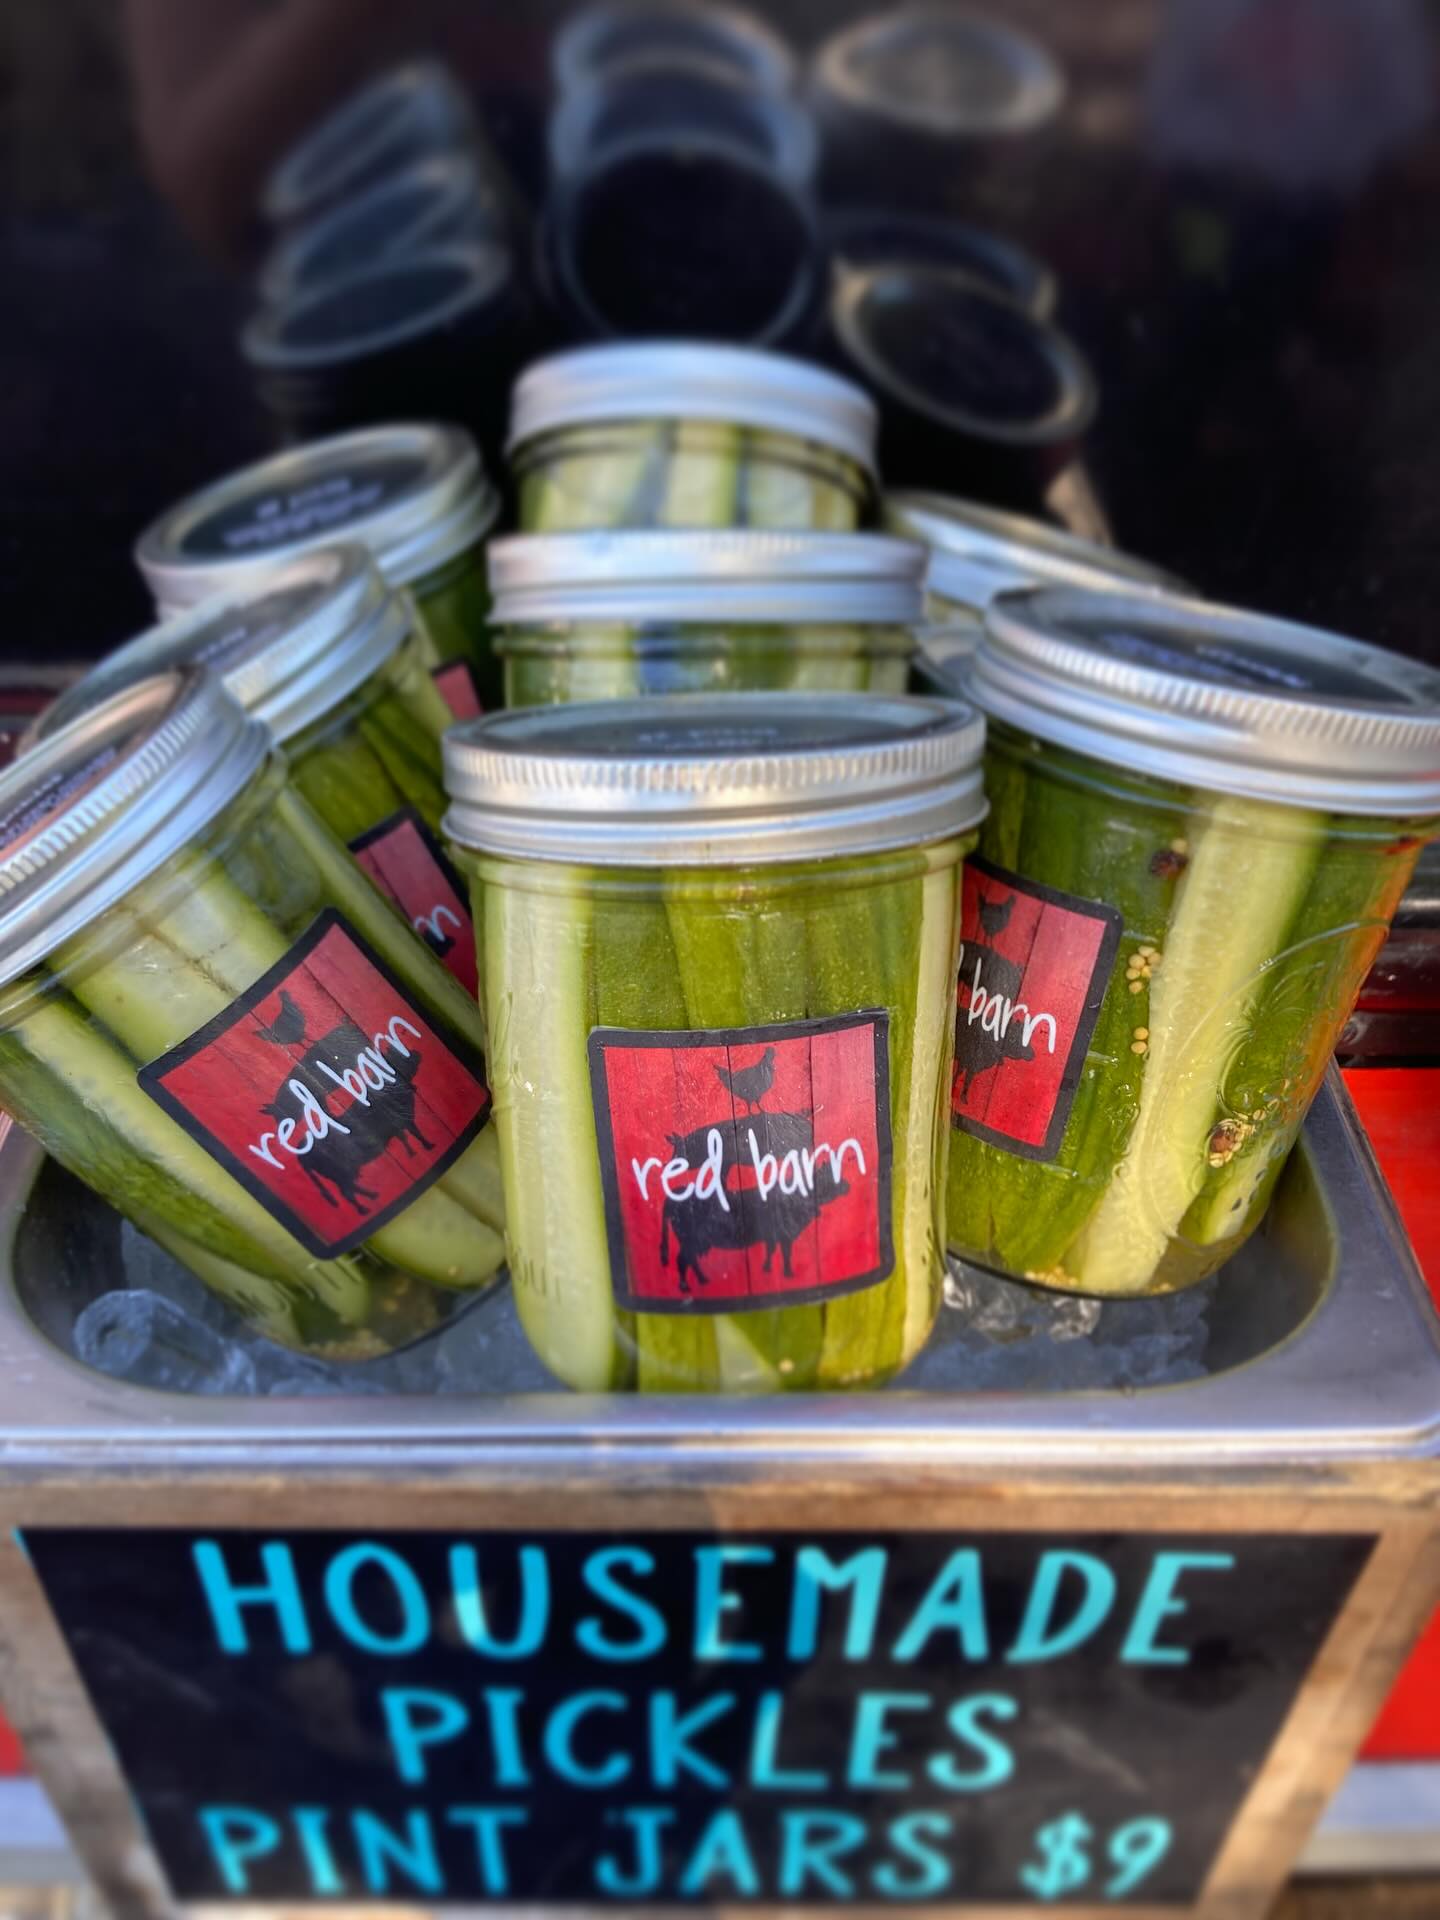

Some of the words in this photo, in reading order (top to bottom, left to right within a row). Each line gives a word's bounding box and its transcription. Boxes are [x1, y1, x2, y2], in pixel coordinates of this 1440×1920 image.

[968, 956, 1056, 1054] barn
[250, 1079, 350, 1170] red
[316, 1015, 421, 1106] barn
[632, 1128, 731, 1212] red
[748, 1128, 866, 1202] barn
[192, 1540, 1235, 1665] HOUSEMADE
[380, 1687, 1018, 1791] PICKLES
[198, 1806, 528, 1893] PINT
[594, 1806, 954, 1898] JARS
[1018, 1810, 1174, 1901] $9
